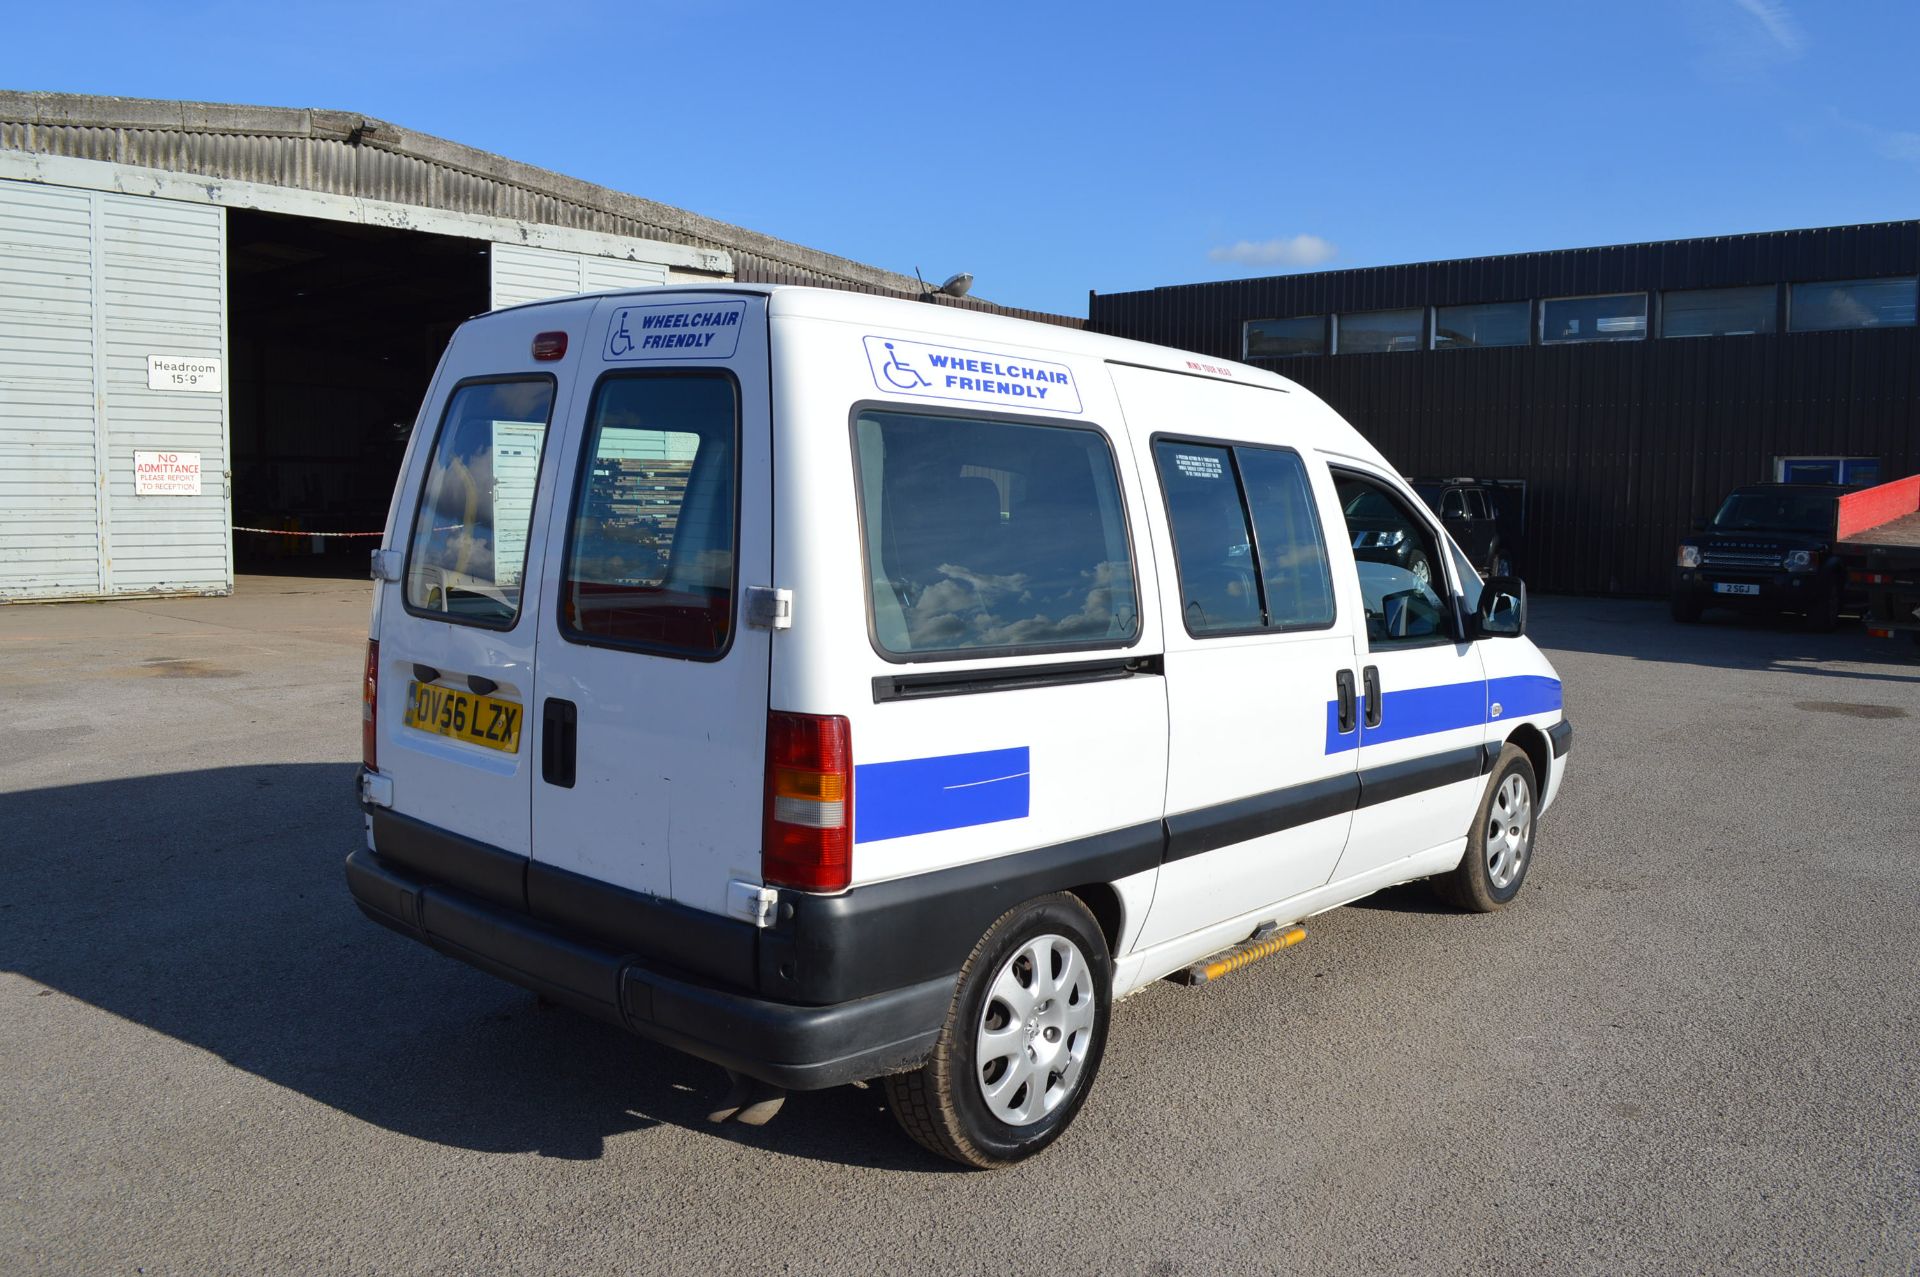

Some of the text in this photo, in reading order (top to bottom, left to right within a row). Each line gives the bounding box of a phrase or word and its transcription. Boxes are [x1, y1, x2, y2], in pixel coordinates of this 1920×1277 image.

[641, 311, 740, 330] WHEELCHAIR
[641, 332, 716, 350] FRIENDLY
[154, 360, 216, 373] Headroom
[928, 353, 1069, 385] WHEELCHAIR
[945, 375, 1049, 399] FRIENDLY
[158, 453, 178, 463] NO
[136, 463, 199, 474] ADMITTANCE
[167, 474, 195, 482] REPORT
[155, 483, 195, 491] RECEPTION
[1726, 584, 1733, 592] 2
[417, 688, 517, 743] DV56 LZX
